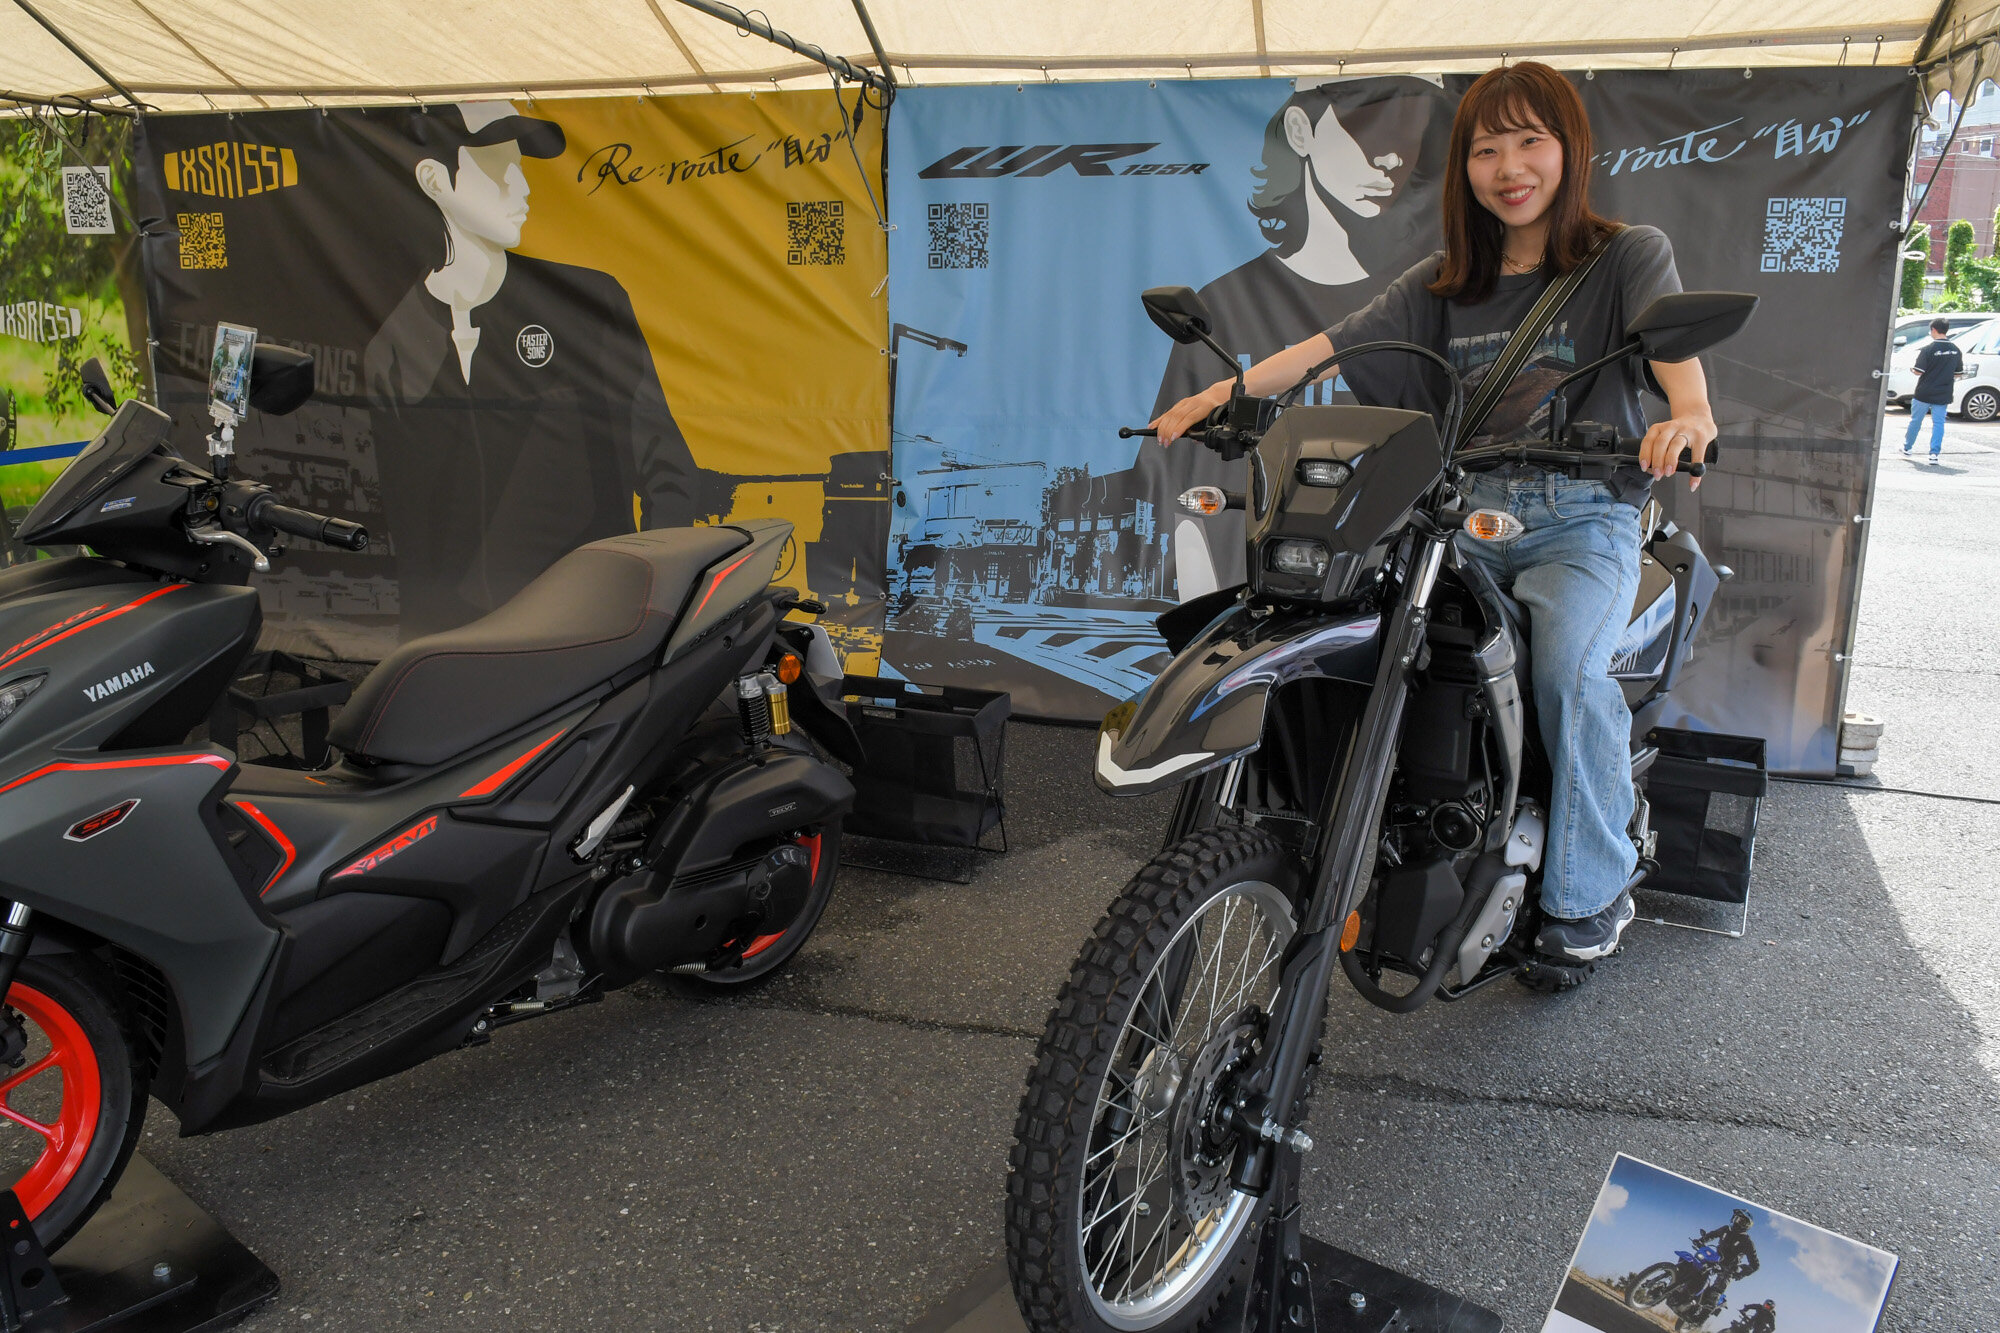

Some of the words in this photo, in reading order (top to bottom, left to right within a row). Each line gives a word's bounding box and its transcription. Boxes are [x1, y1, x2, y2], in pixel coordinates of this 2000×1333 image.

[1119, 163, 1211, 176] 125R
[521, 333, 548, 347] FASTER
[527, 346, 546, 359] SONS
[291, 338, 357, 397] ONS
[83, 661, 155, 702] YAMAHA
[81, 809, 121, 834] SP
